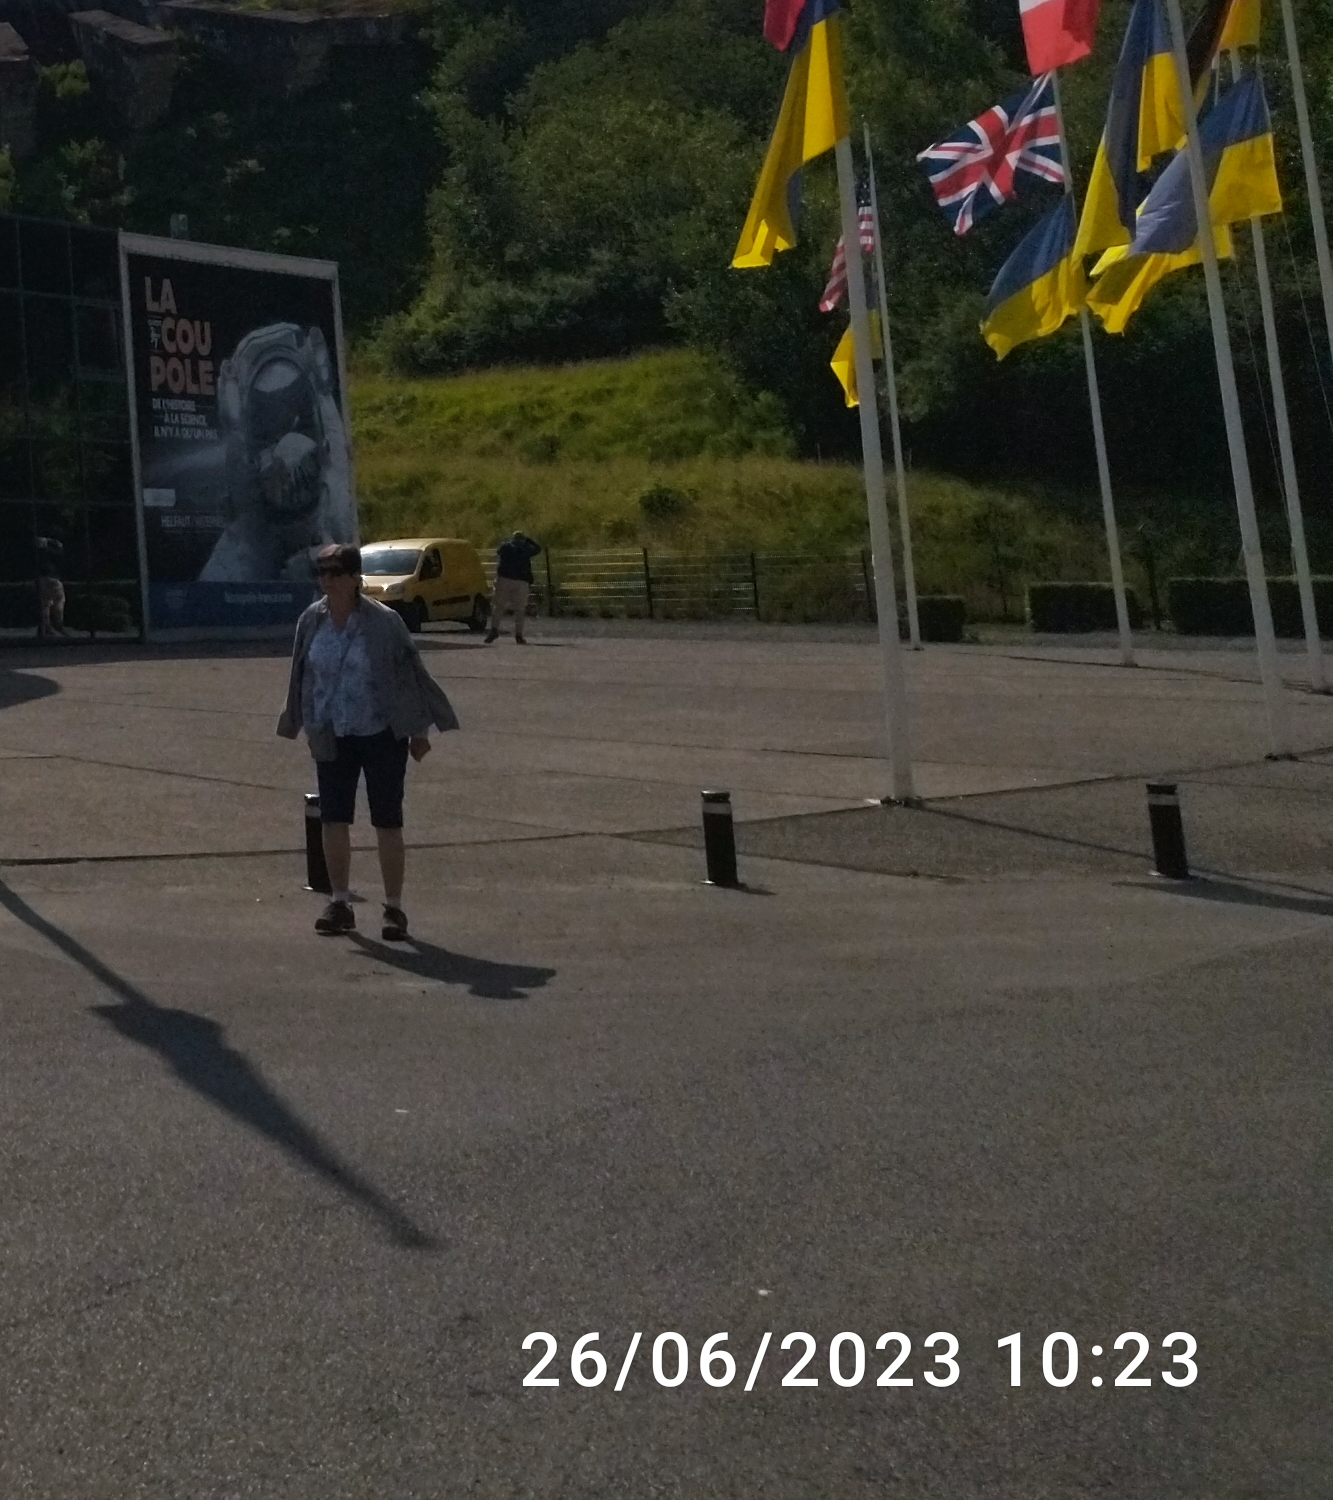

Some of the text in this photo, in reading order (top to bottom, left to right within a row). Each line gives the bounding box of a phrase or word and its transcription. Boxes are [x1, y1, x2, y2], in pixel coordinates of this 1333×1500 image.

[144, 275, 178, 315] LA
[161, 316, 212, 356] COU
[149, 355, 215, 395] POLE
